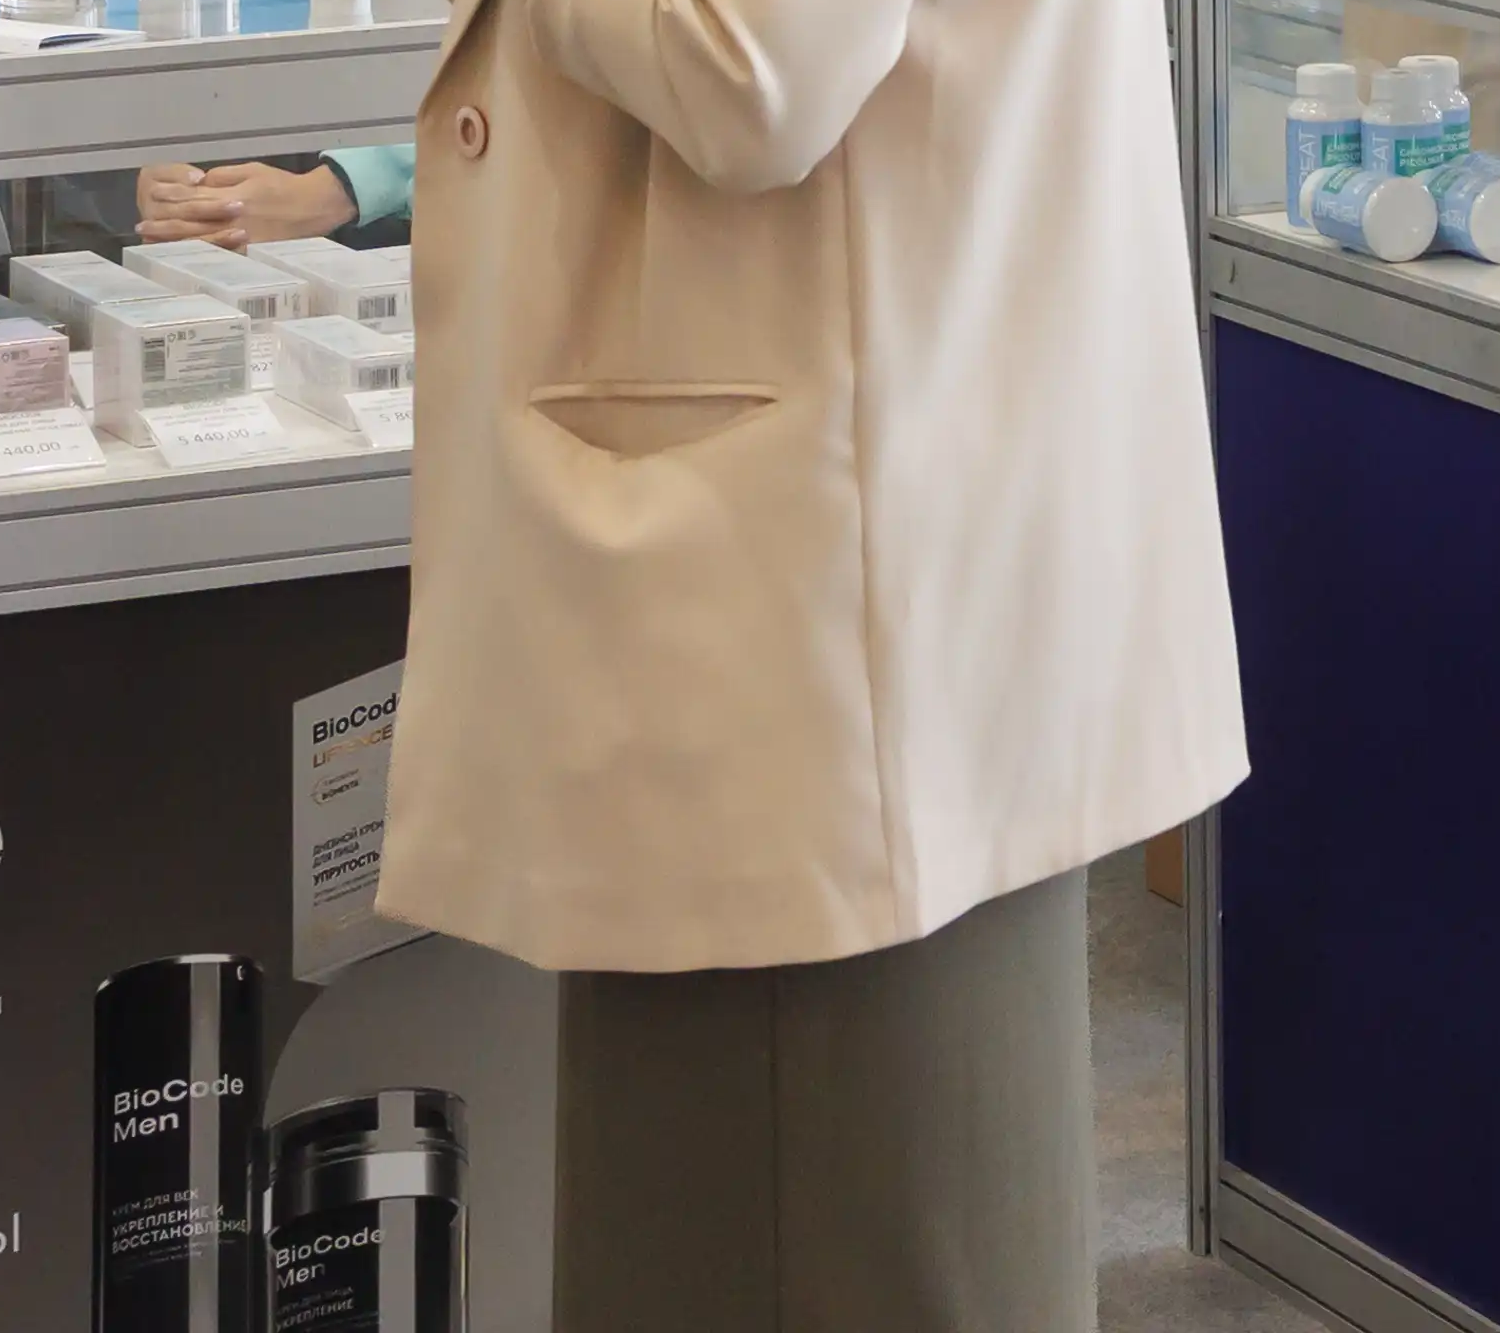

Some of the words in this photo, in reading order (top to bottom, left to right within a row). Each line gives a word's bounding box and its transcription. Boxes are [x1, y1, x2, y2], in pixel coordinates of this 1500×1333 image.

[3, 441, 61, 456] 440,00
[312, 692, 401, 745] BioCod
[313, 849, 381, 886] УПРУГОСТЬ
[113, 1073, 244, 1116] BioCode
[113, 1111, 180, 1143] Men
[143, 1192, 170, 1209] ДЛЯ
[174, 1187, 199, 1203] ВЕК
[111, 1218, 248, 1255] ВОССТАНОВЛЕНИЕ
[112, 1205, 209, 1236] УКРЕПЛЕНИЕ
[275, 1226, 386, 1269] BioCode
[275, 1261, 326, 1293] Men
[275, 1297, 355, 1333] УКРЕПЛЕНИЕ
